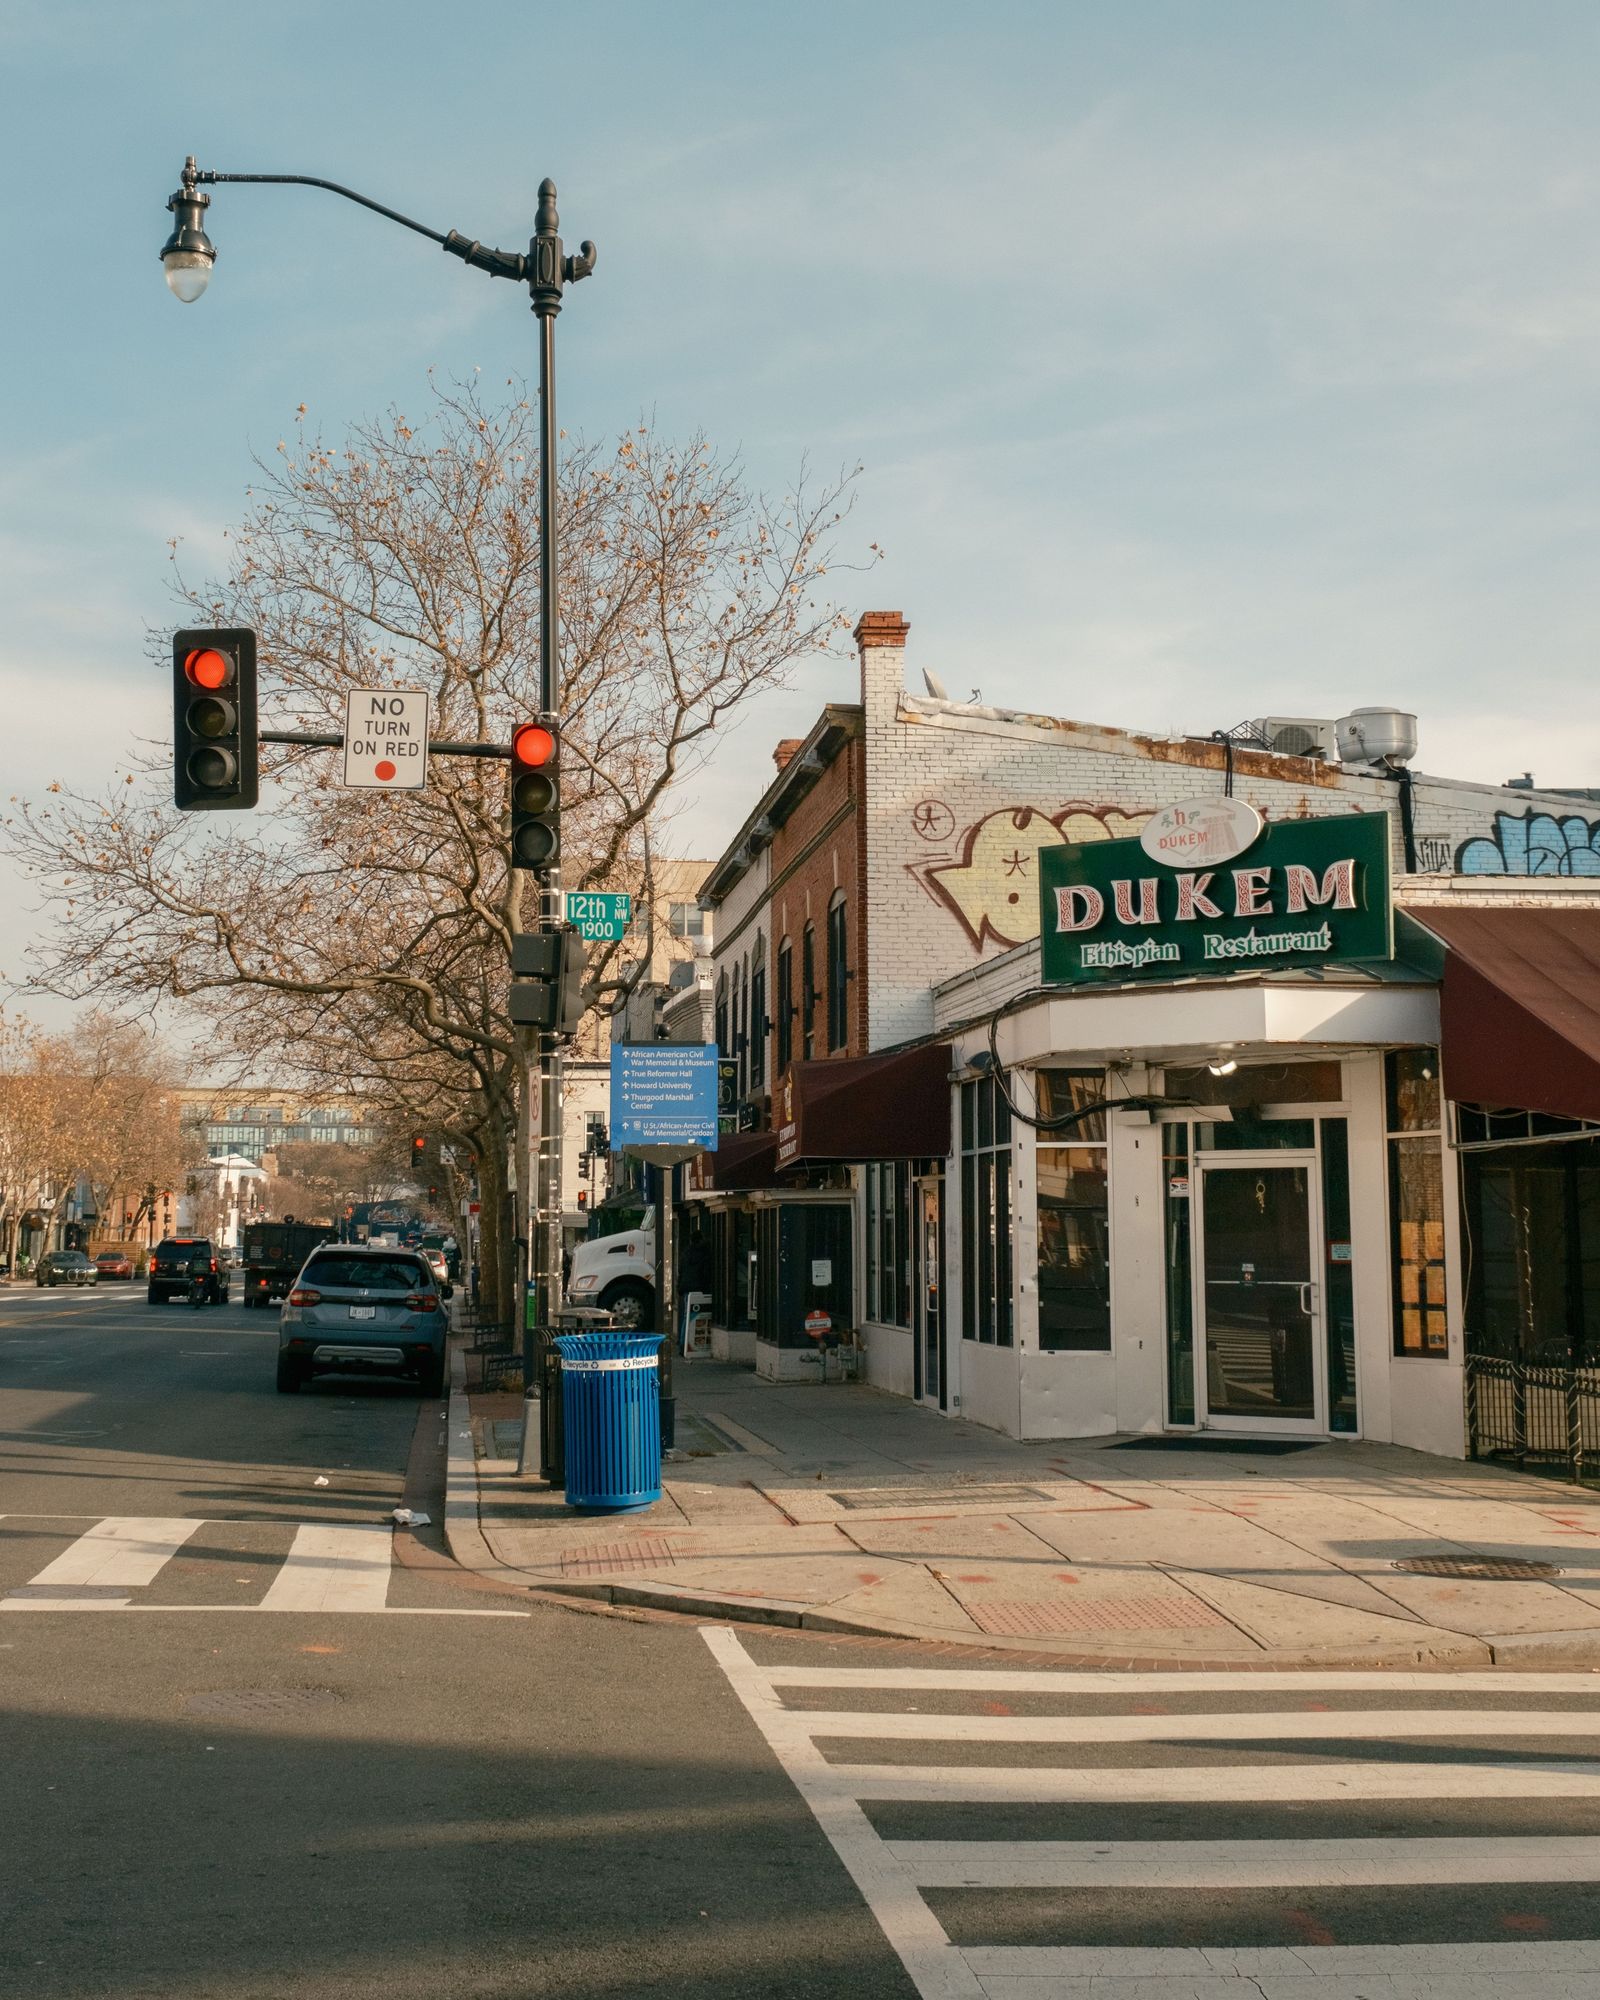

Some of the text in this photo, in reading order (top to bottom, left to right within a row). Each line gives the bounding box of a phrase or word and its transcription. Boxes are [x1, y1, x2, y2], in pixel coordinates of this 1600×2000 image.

[370, 697, 405, 716] NO
[365, 720, 411, 737] TURN
[352, 740, 420, 757] ON RED
[1159, 832, 1209, 850] DUKEM
[1053, 858, 1357, 933] DUKEM
[569, 895, 628, 920] 12th ST NW
[580, 921, 614, 938] 1900
[1080, 921, 1334, 968] Ethiopian Restaurant
[659, 1082, 693, 1090] University
[631, 1094, 664, 1102] Thurgood
[566, 1358, 654, 1370] Recycle Recycle
